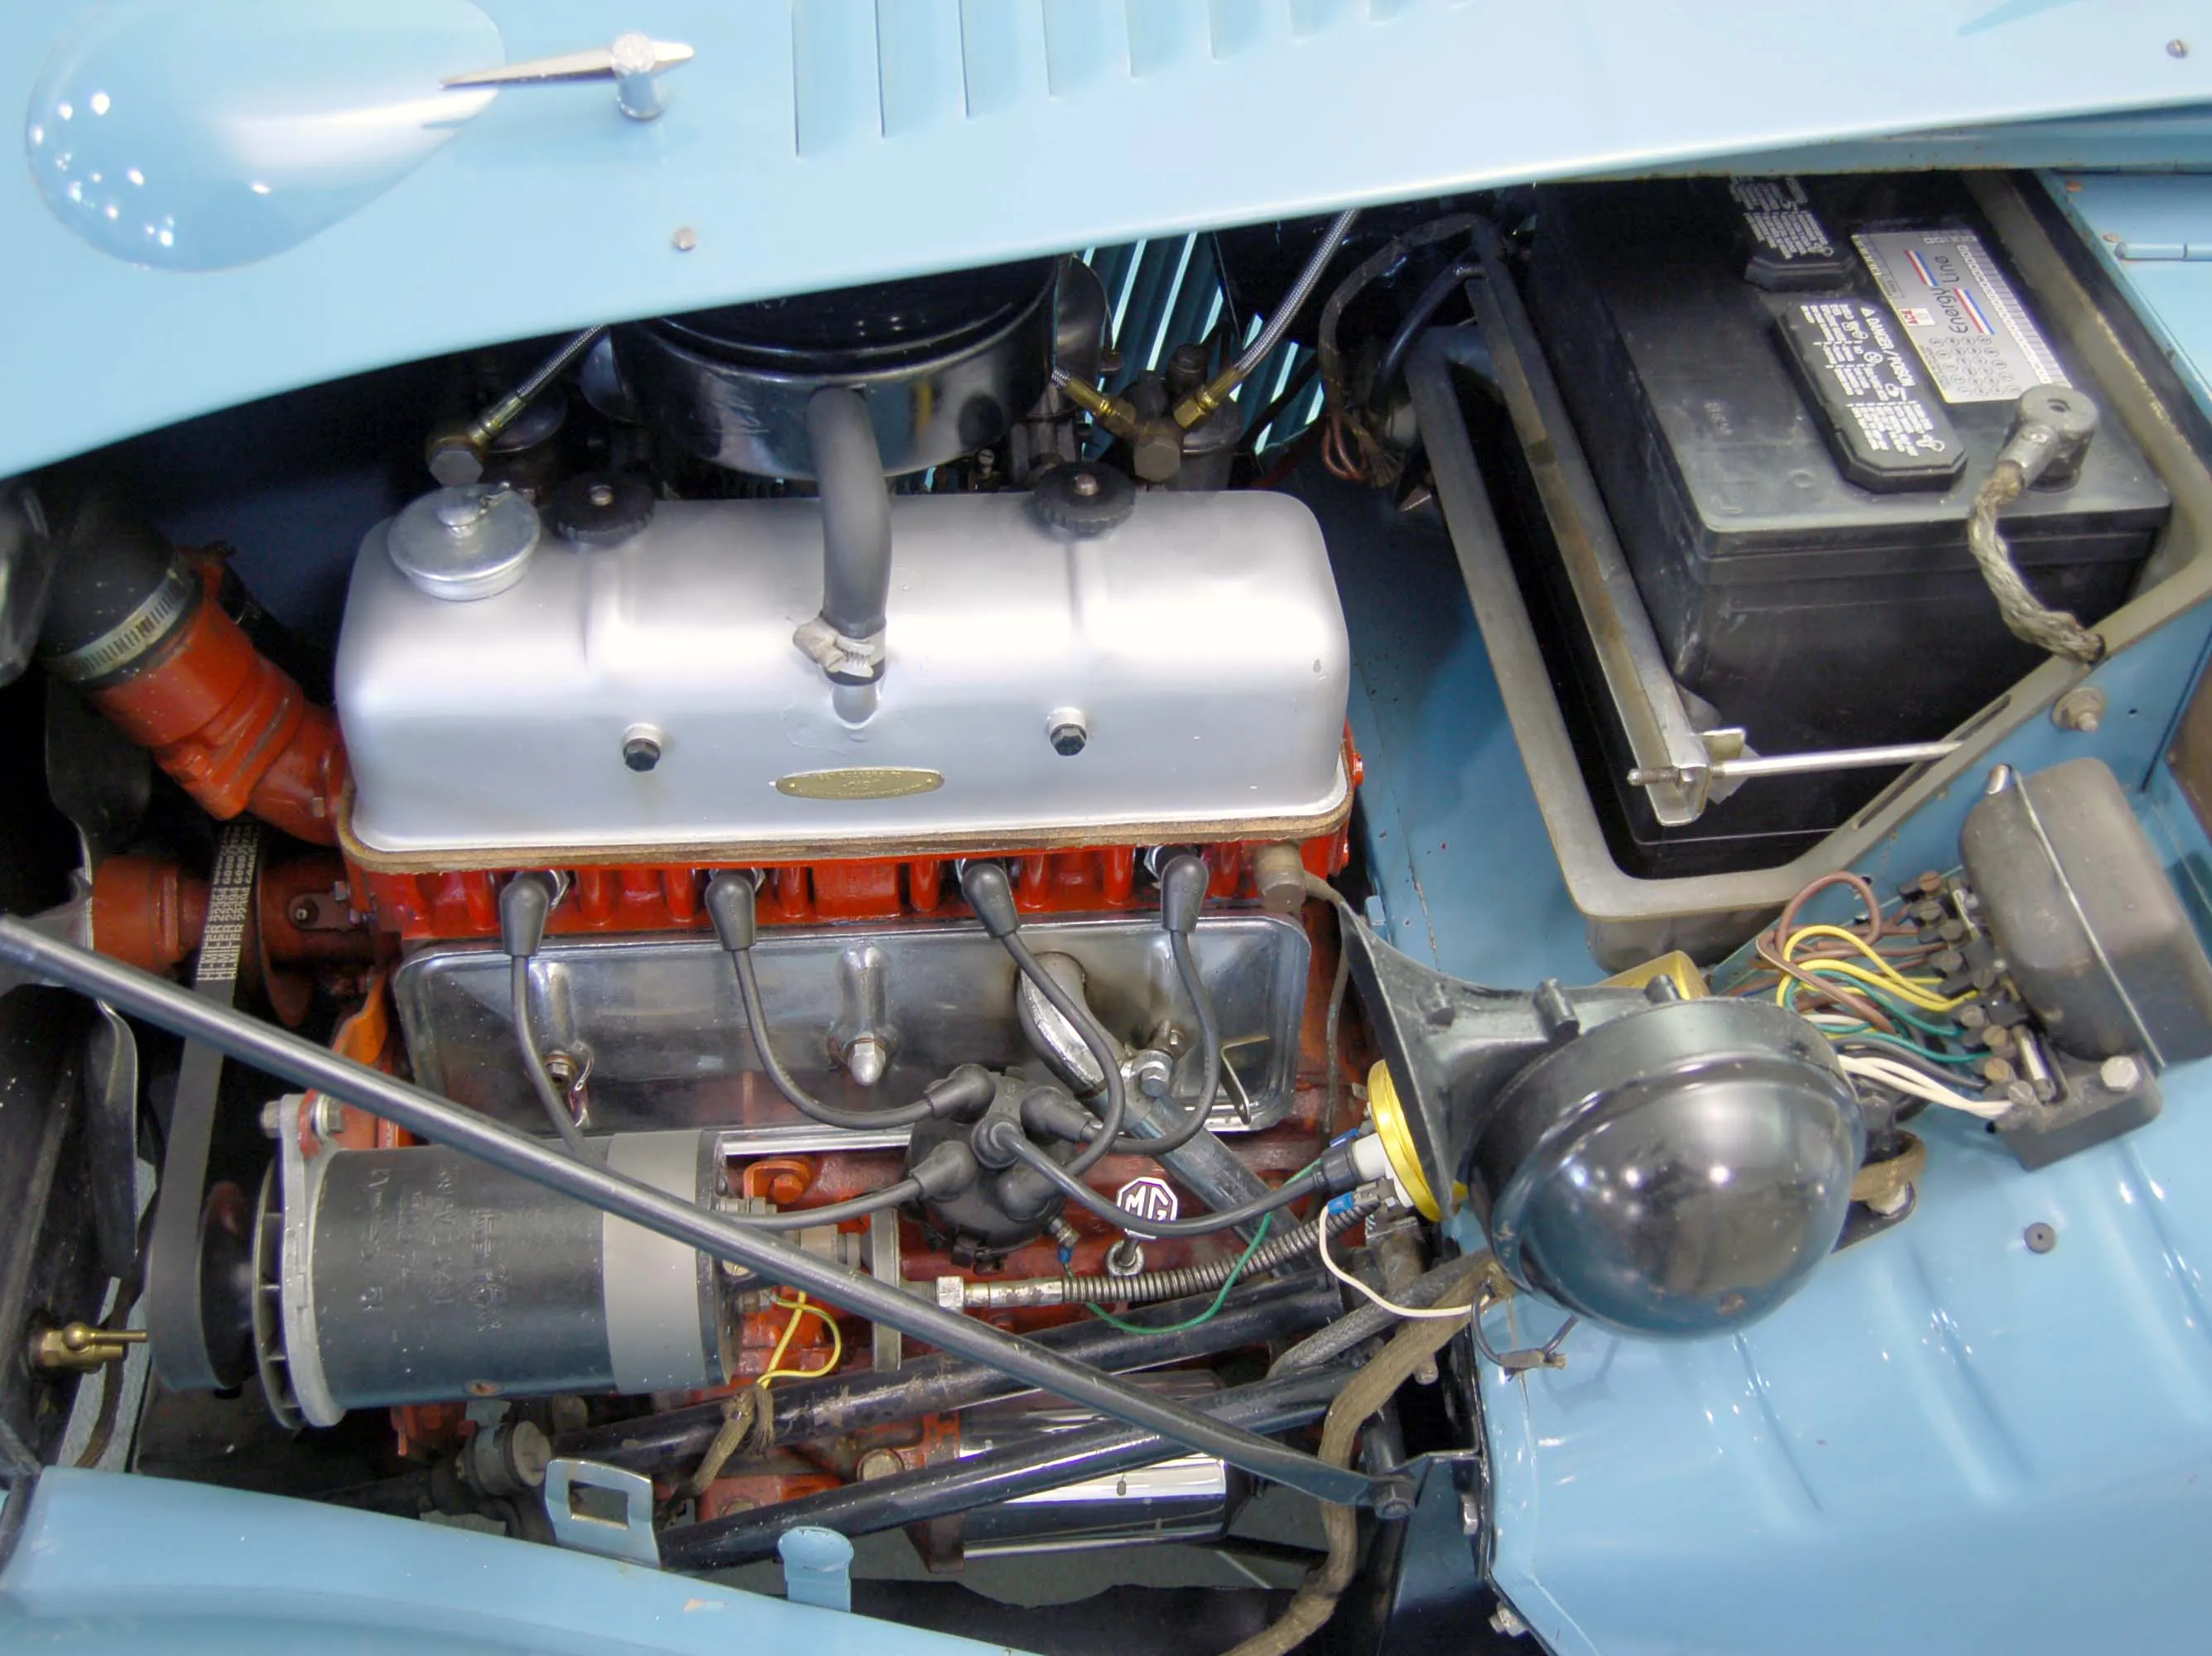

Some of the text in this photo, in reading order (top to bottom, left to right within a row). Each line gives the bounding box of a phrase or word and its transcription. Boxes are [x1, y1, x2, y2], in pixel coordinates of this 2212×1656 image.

[1934, 255, 1960, 283] Line
[1931, 286, 1969, 334] Energy
[212, 888, 228, 920] 22394
[214, 924, 233, 980] HI-MILER
[224, 888, 238, 920] 22394
[1123, 1184, 1170, 1221] MG
